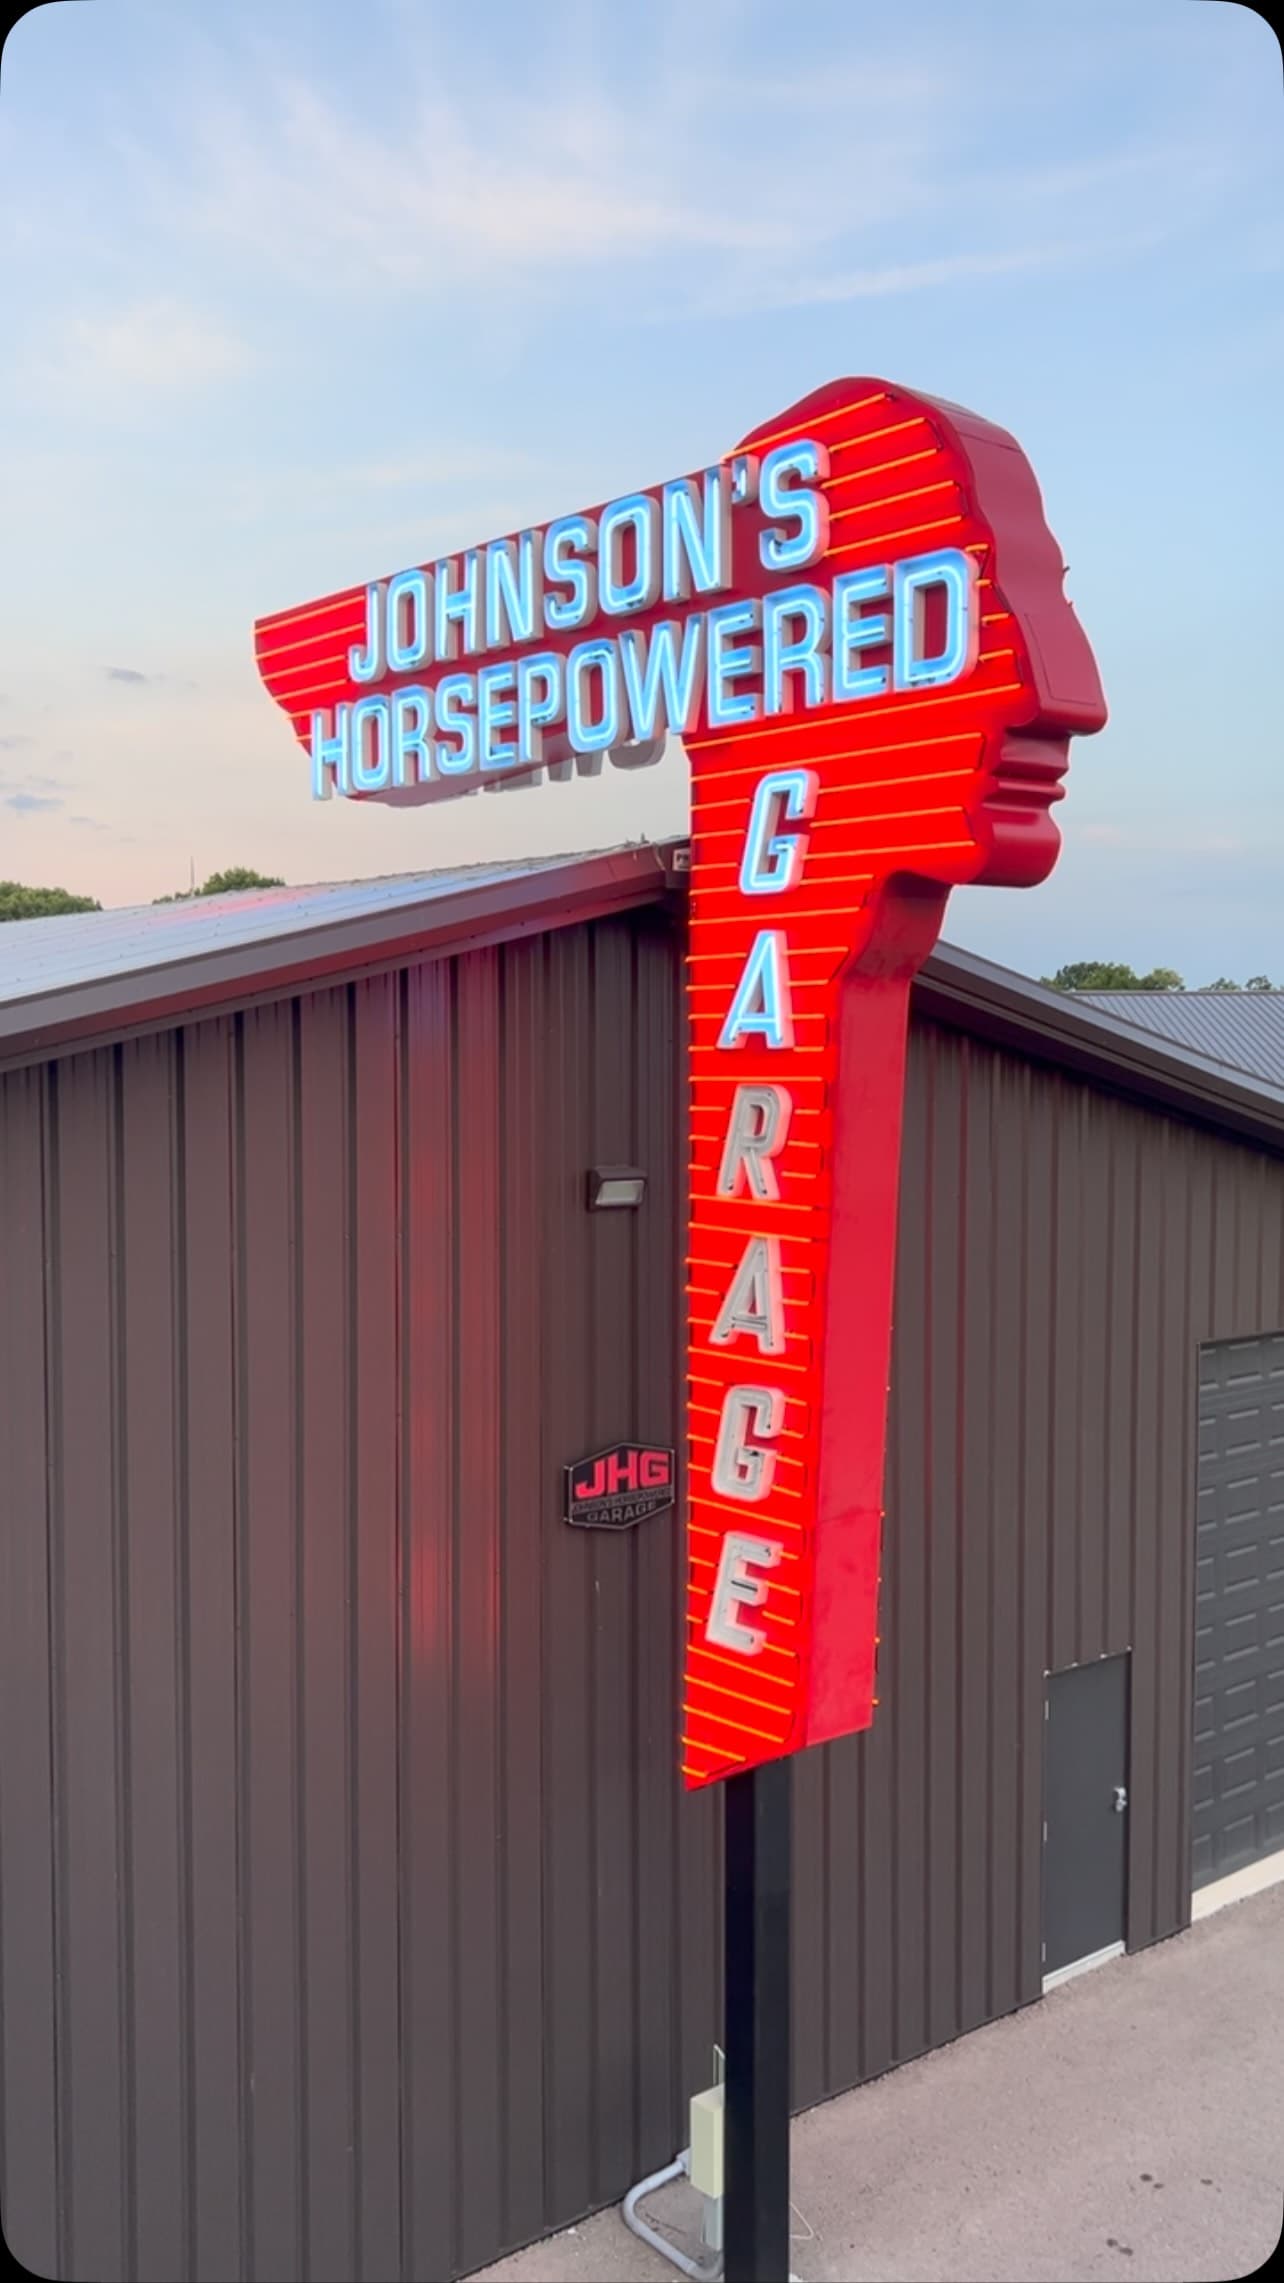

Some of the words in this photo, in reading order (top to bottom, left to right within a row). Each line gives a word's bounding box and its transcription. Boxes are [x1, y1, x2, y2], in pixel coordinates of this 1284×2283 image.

[310, 546, 980, 801] HORSEPOWERED
[348, 438, 830, 683] JOHNSON'S
[704, 767, 820, 1656] GARAGE
[575, 1449, 670, 1499] JHG
